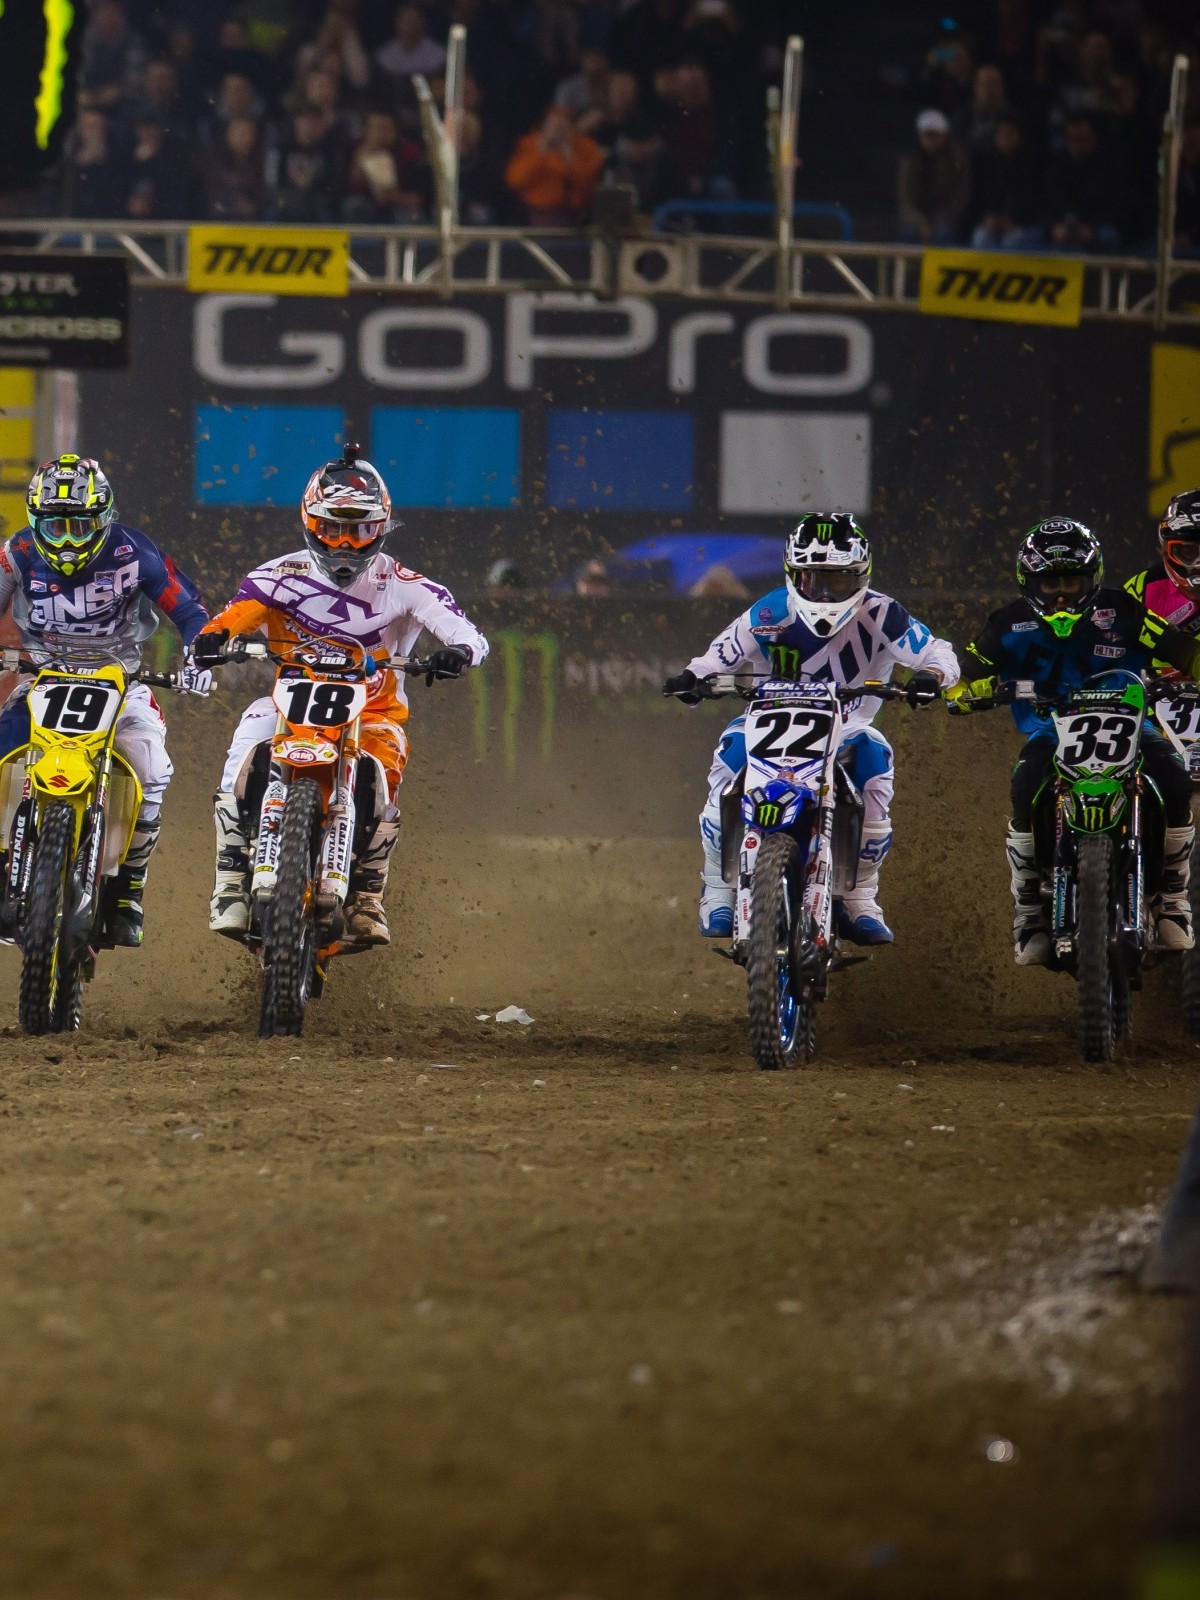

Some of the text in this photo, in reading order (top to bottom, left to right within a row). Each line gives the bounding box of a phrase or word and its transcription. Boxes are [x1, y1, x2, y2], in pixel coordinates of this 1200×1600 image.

[201, 240, 334, 280] THOR
[935, 265, 1067, 308] THOR
[193, 293, 873, 393] GoPro
[44, 619, 116, 637] RCH
[41, 685, 110, 732] 19
[286, 681, 355, 727] 18
[751, 711, 833, 759] 22
[1063, 715, 1137, 765] 33
[11, 814, 26, 887] DUNLOP
